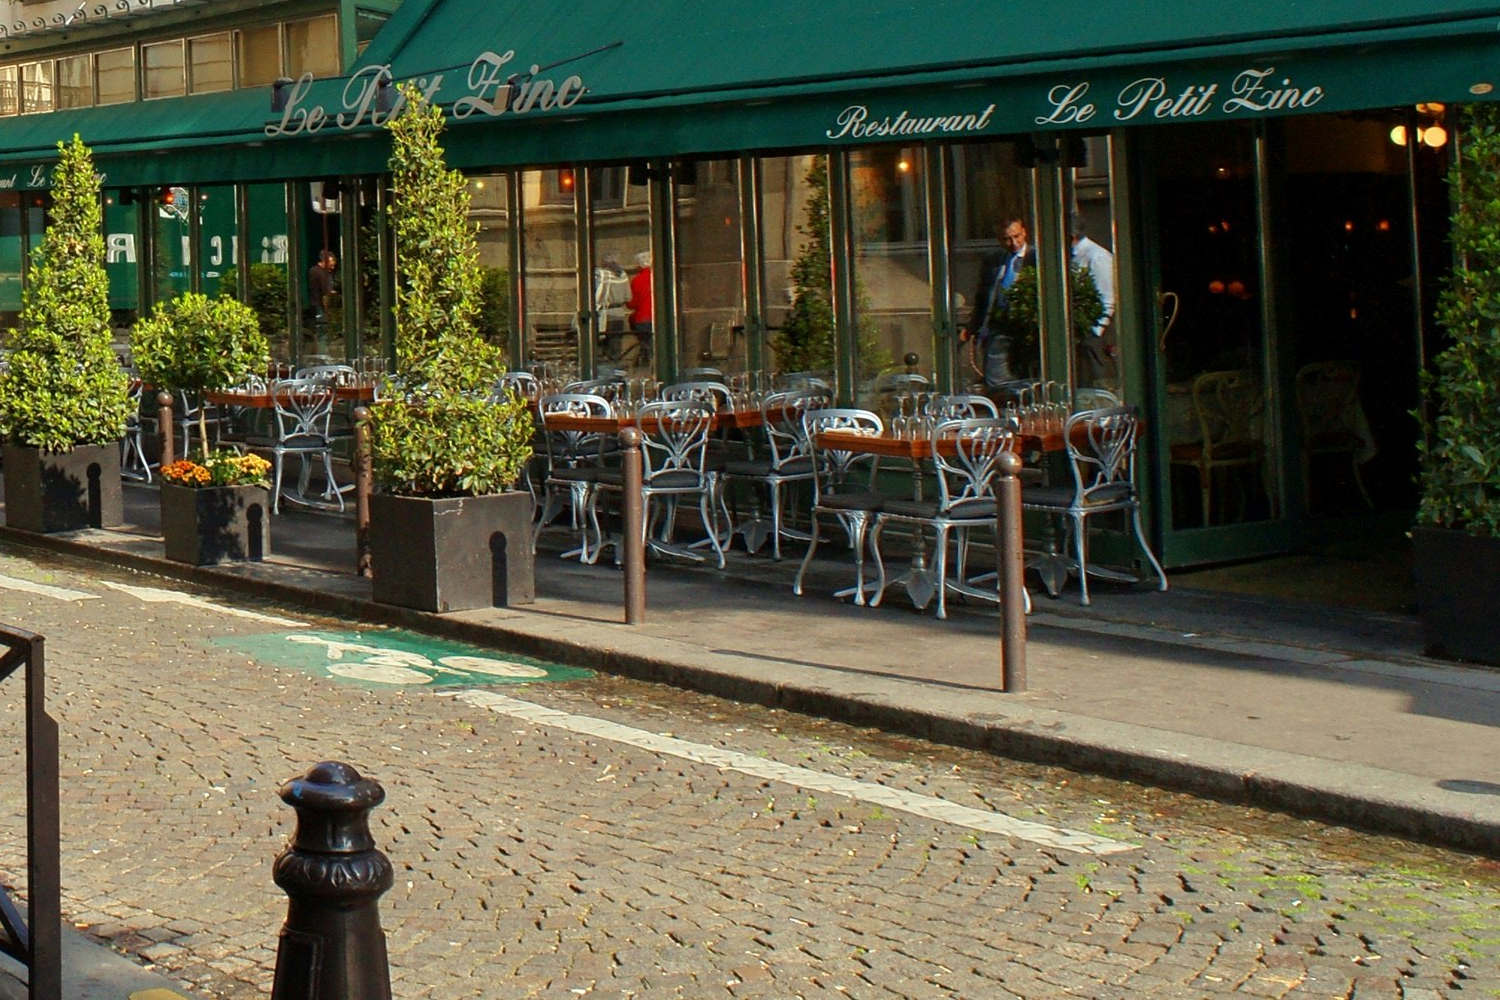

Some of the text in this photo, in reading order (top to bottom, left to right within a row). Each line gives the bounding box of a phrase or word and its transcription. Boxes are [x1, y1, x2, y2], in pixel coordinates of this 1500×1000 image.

[264, 71, 328, 138] Le
[453, 50, 586, 120] Zinc
[826, 67, 1325, 139] Restaurant Le Petit Zinc
[26, 164, 46, 188] Le
